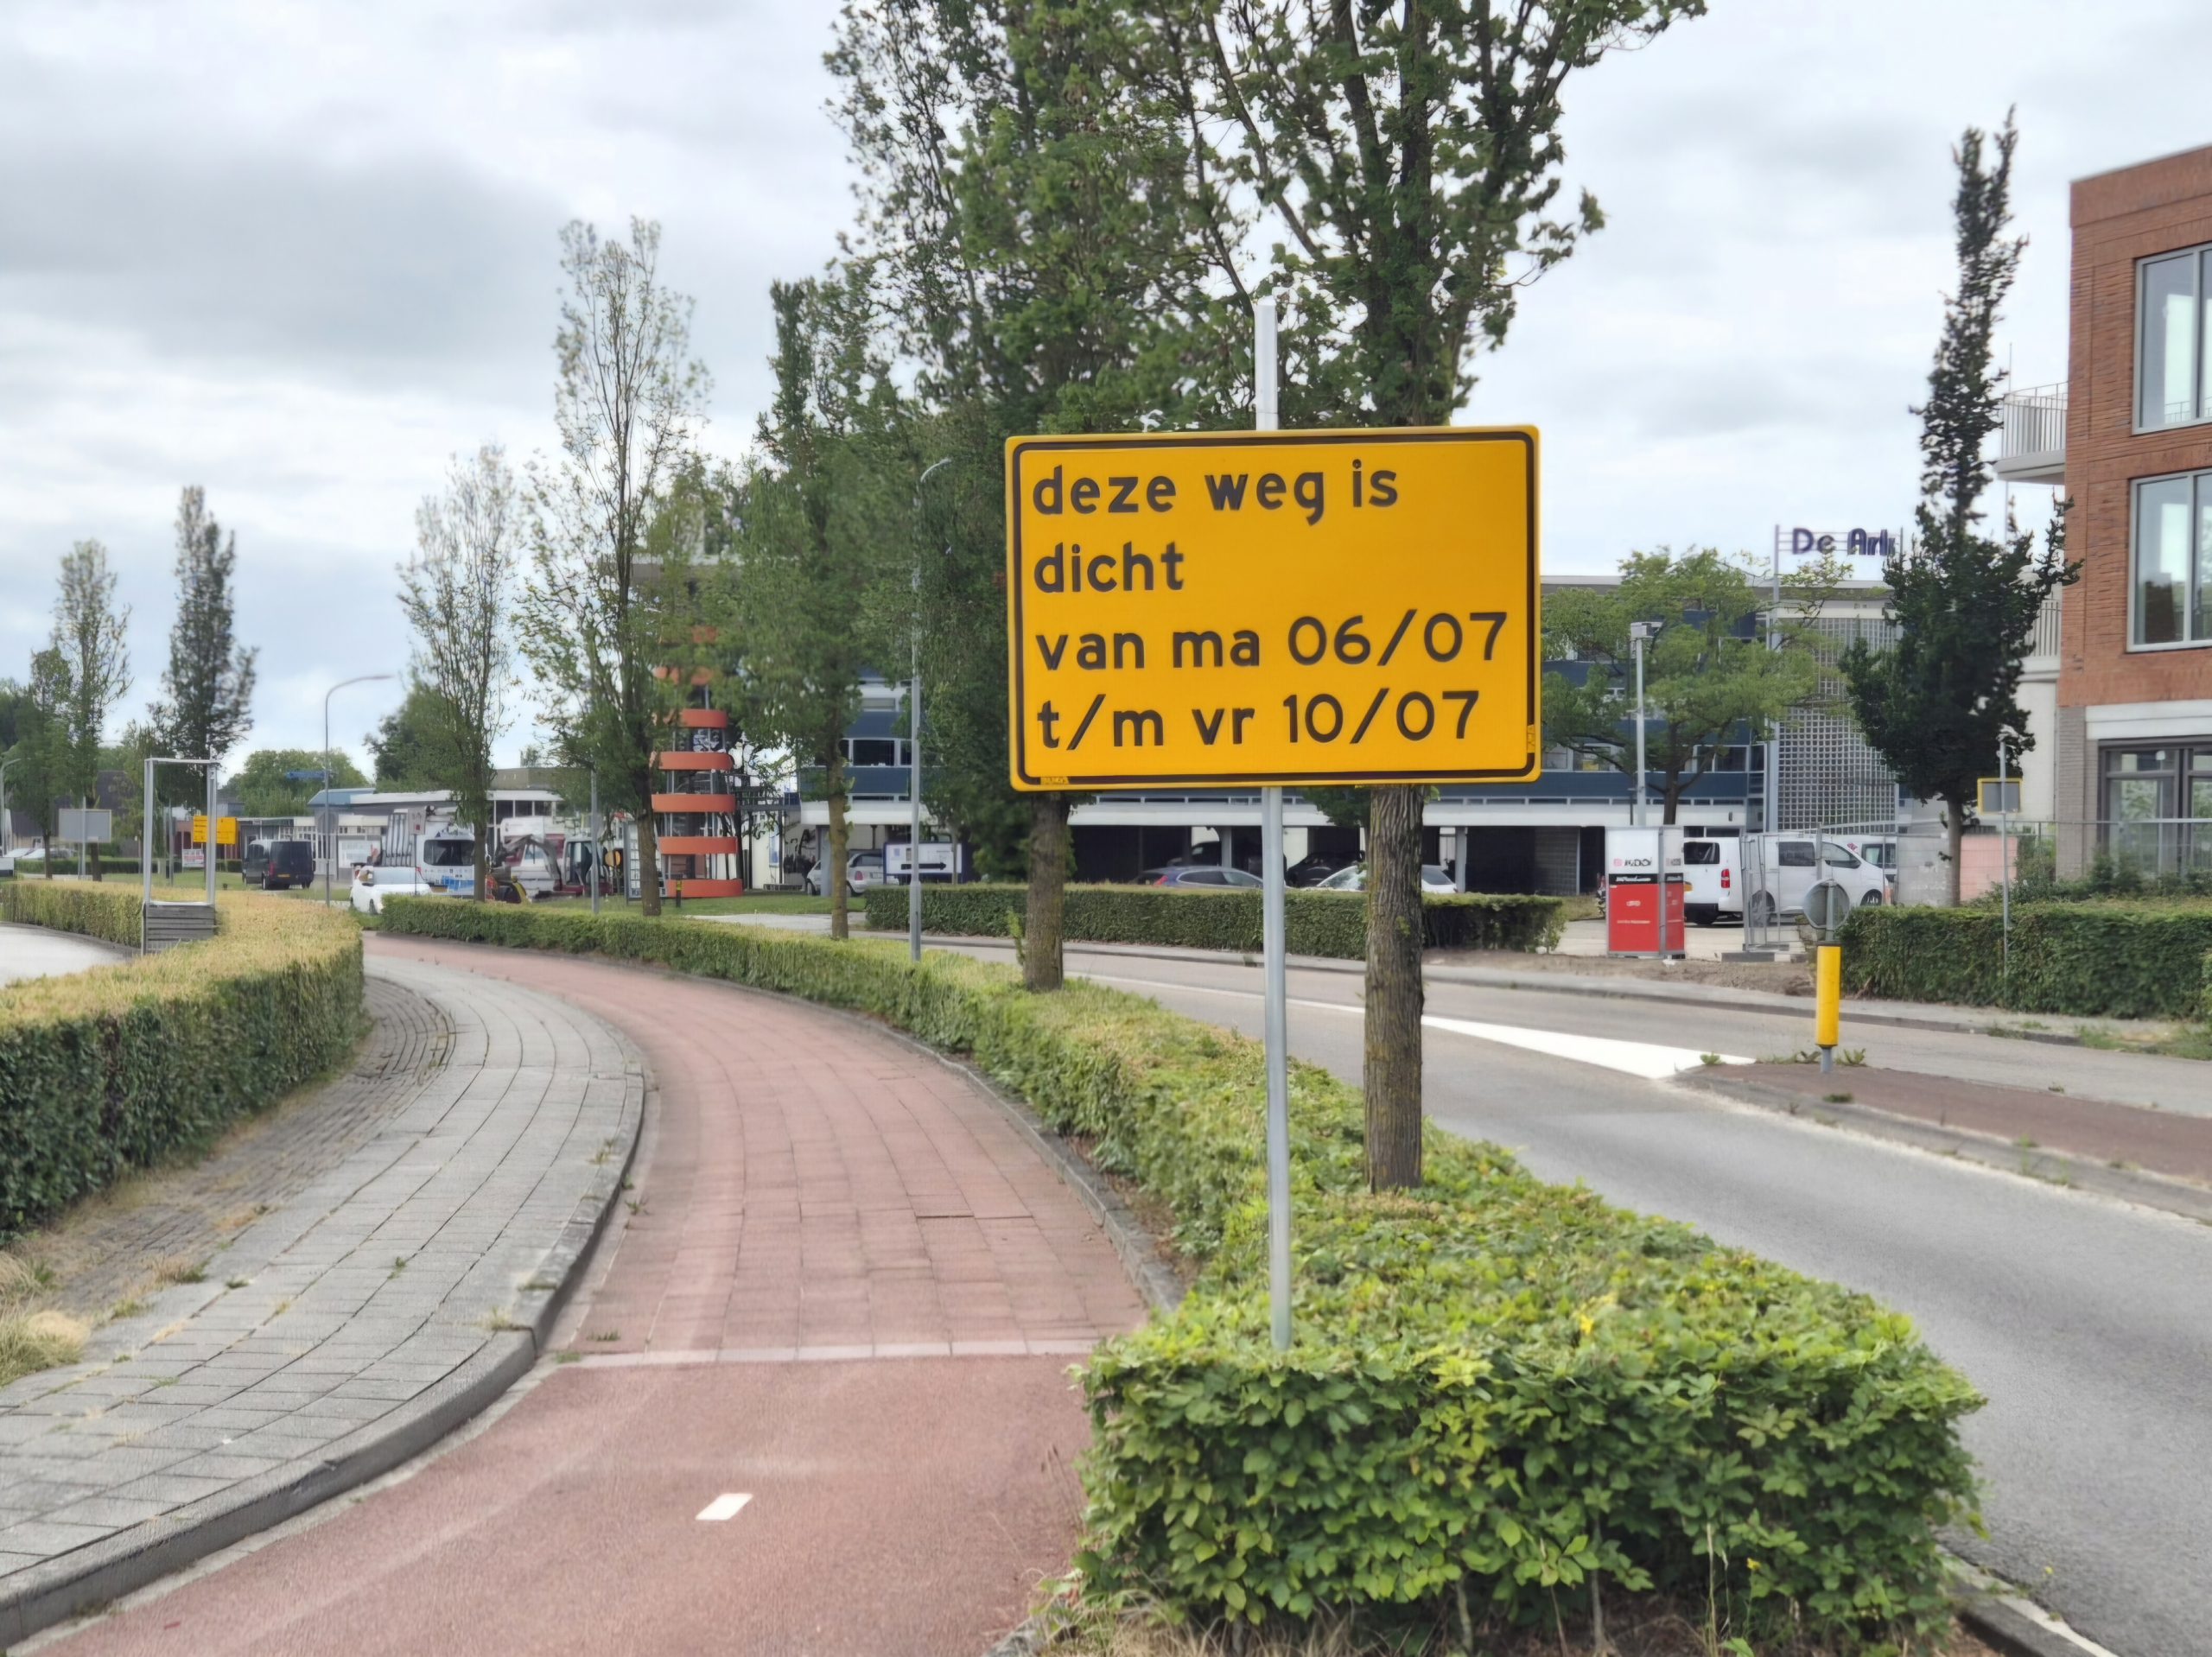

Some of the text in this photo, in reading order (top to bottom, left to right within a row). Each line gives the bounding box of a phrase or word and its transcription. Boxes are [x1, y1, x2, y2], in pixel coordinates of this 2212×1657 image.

[1033, 458, 1399, 526] deze weg is
[1033, 541, 1185, 594] dicht
[1792, 528, 1835, 554] De
[1035, 608, 1508, 671] van ma 06/07
[1036, 687, 1480, 751] t/m vr 10/07
